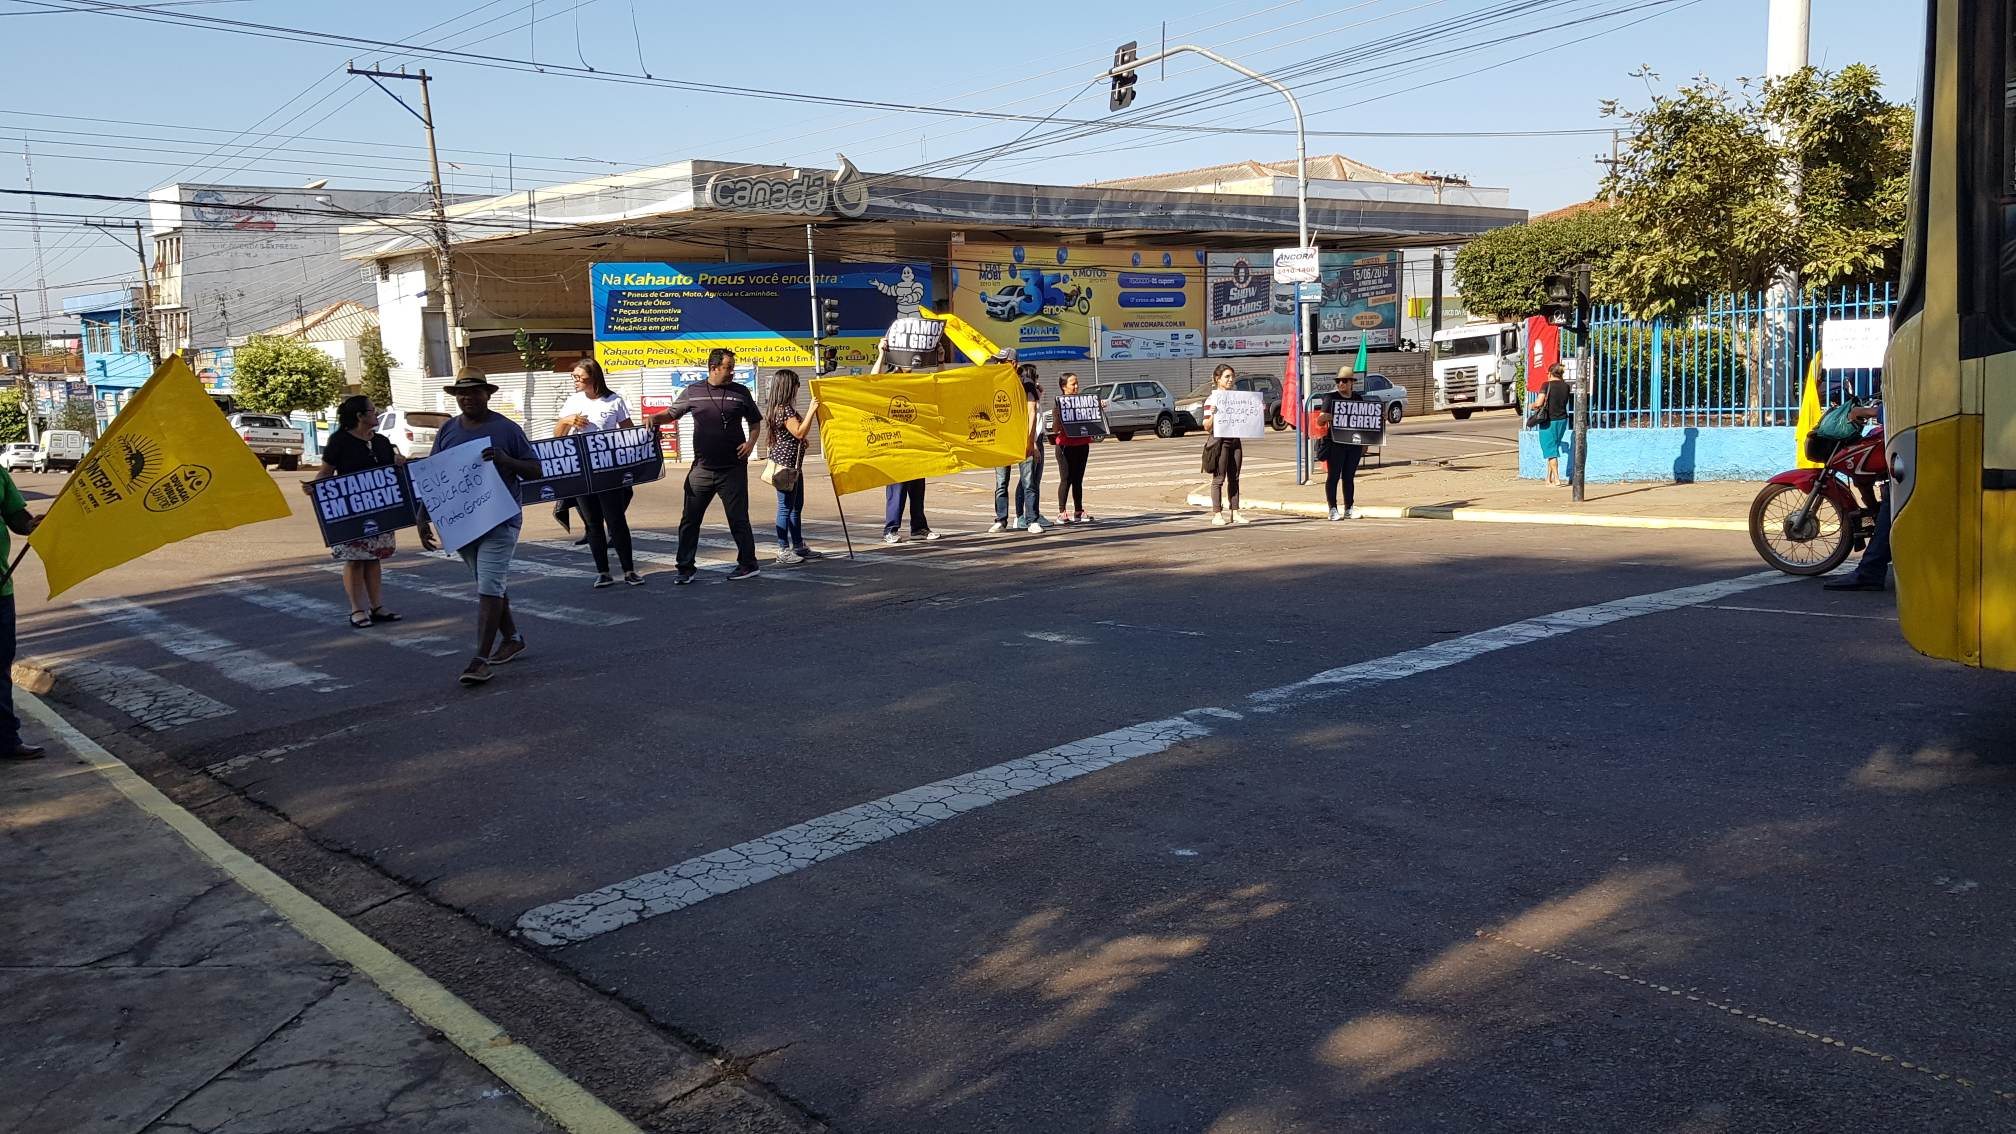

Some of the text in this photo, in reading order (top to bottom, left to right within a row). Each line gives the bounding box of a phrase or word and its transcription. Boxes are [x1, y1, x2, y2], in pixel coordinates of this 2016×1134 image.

[602, 274, 620, 286] Na
[624, 273, 694, 286] Kahauto
[698, 273, 746, 285] Pneus
[750, 272, 779, 284] você
[979, 271, 1002, 280] MOBI
[1079, 269, 1107, 278] MOTOS
[1353, 266, 1389, 280] 15/06/2019
[654, 298, 671, 306] Óleo
[1043, 304, 1066, 314] anos
[619, 308, 640, 316] Peças
[616, 316, 642, 324] Injeção
[613, 324, 648, 332] Mecânica
[661, 324, 680, 332] geral
[604, 346, 644, 356] Kahauto
[734, 345, 762, 353] Correia
[775, 344, 799, 353] Costa,
[604, 358, 644, 366] Kahauto
[1059, 395, 1100, 409] ESTAMOS
[1334, 402, 1382, 416] ESTAMOS
[1062, 407, 1101, 422] EM GREVE
[1332, 414, 1381, 429] EM GREVE
[586, 426, 654, 452] ESTAMOS
[590, 442, 656, 470] EM GREVE
[541, 456, 580, 478] REVE
[315, 466, 398, 502] ESTAMOS
[320, 484, 404, 520] EM GREVE
